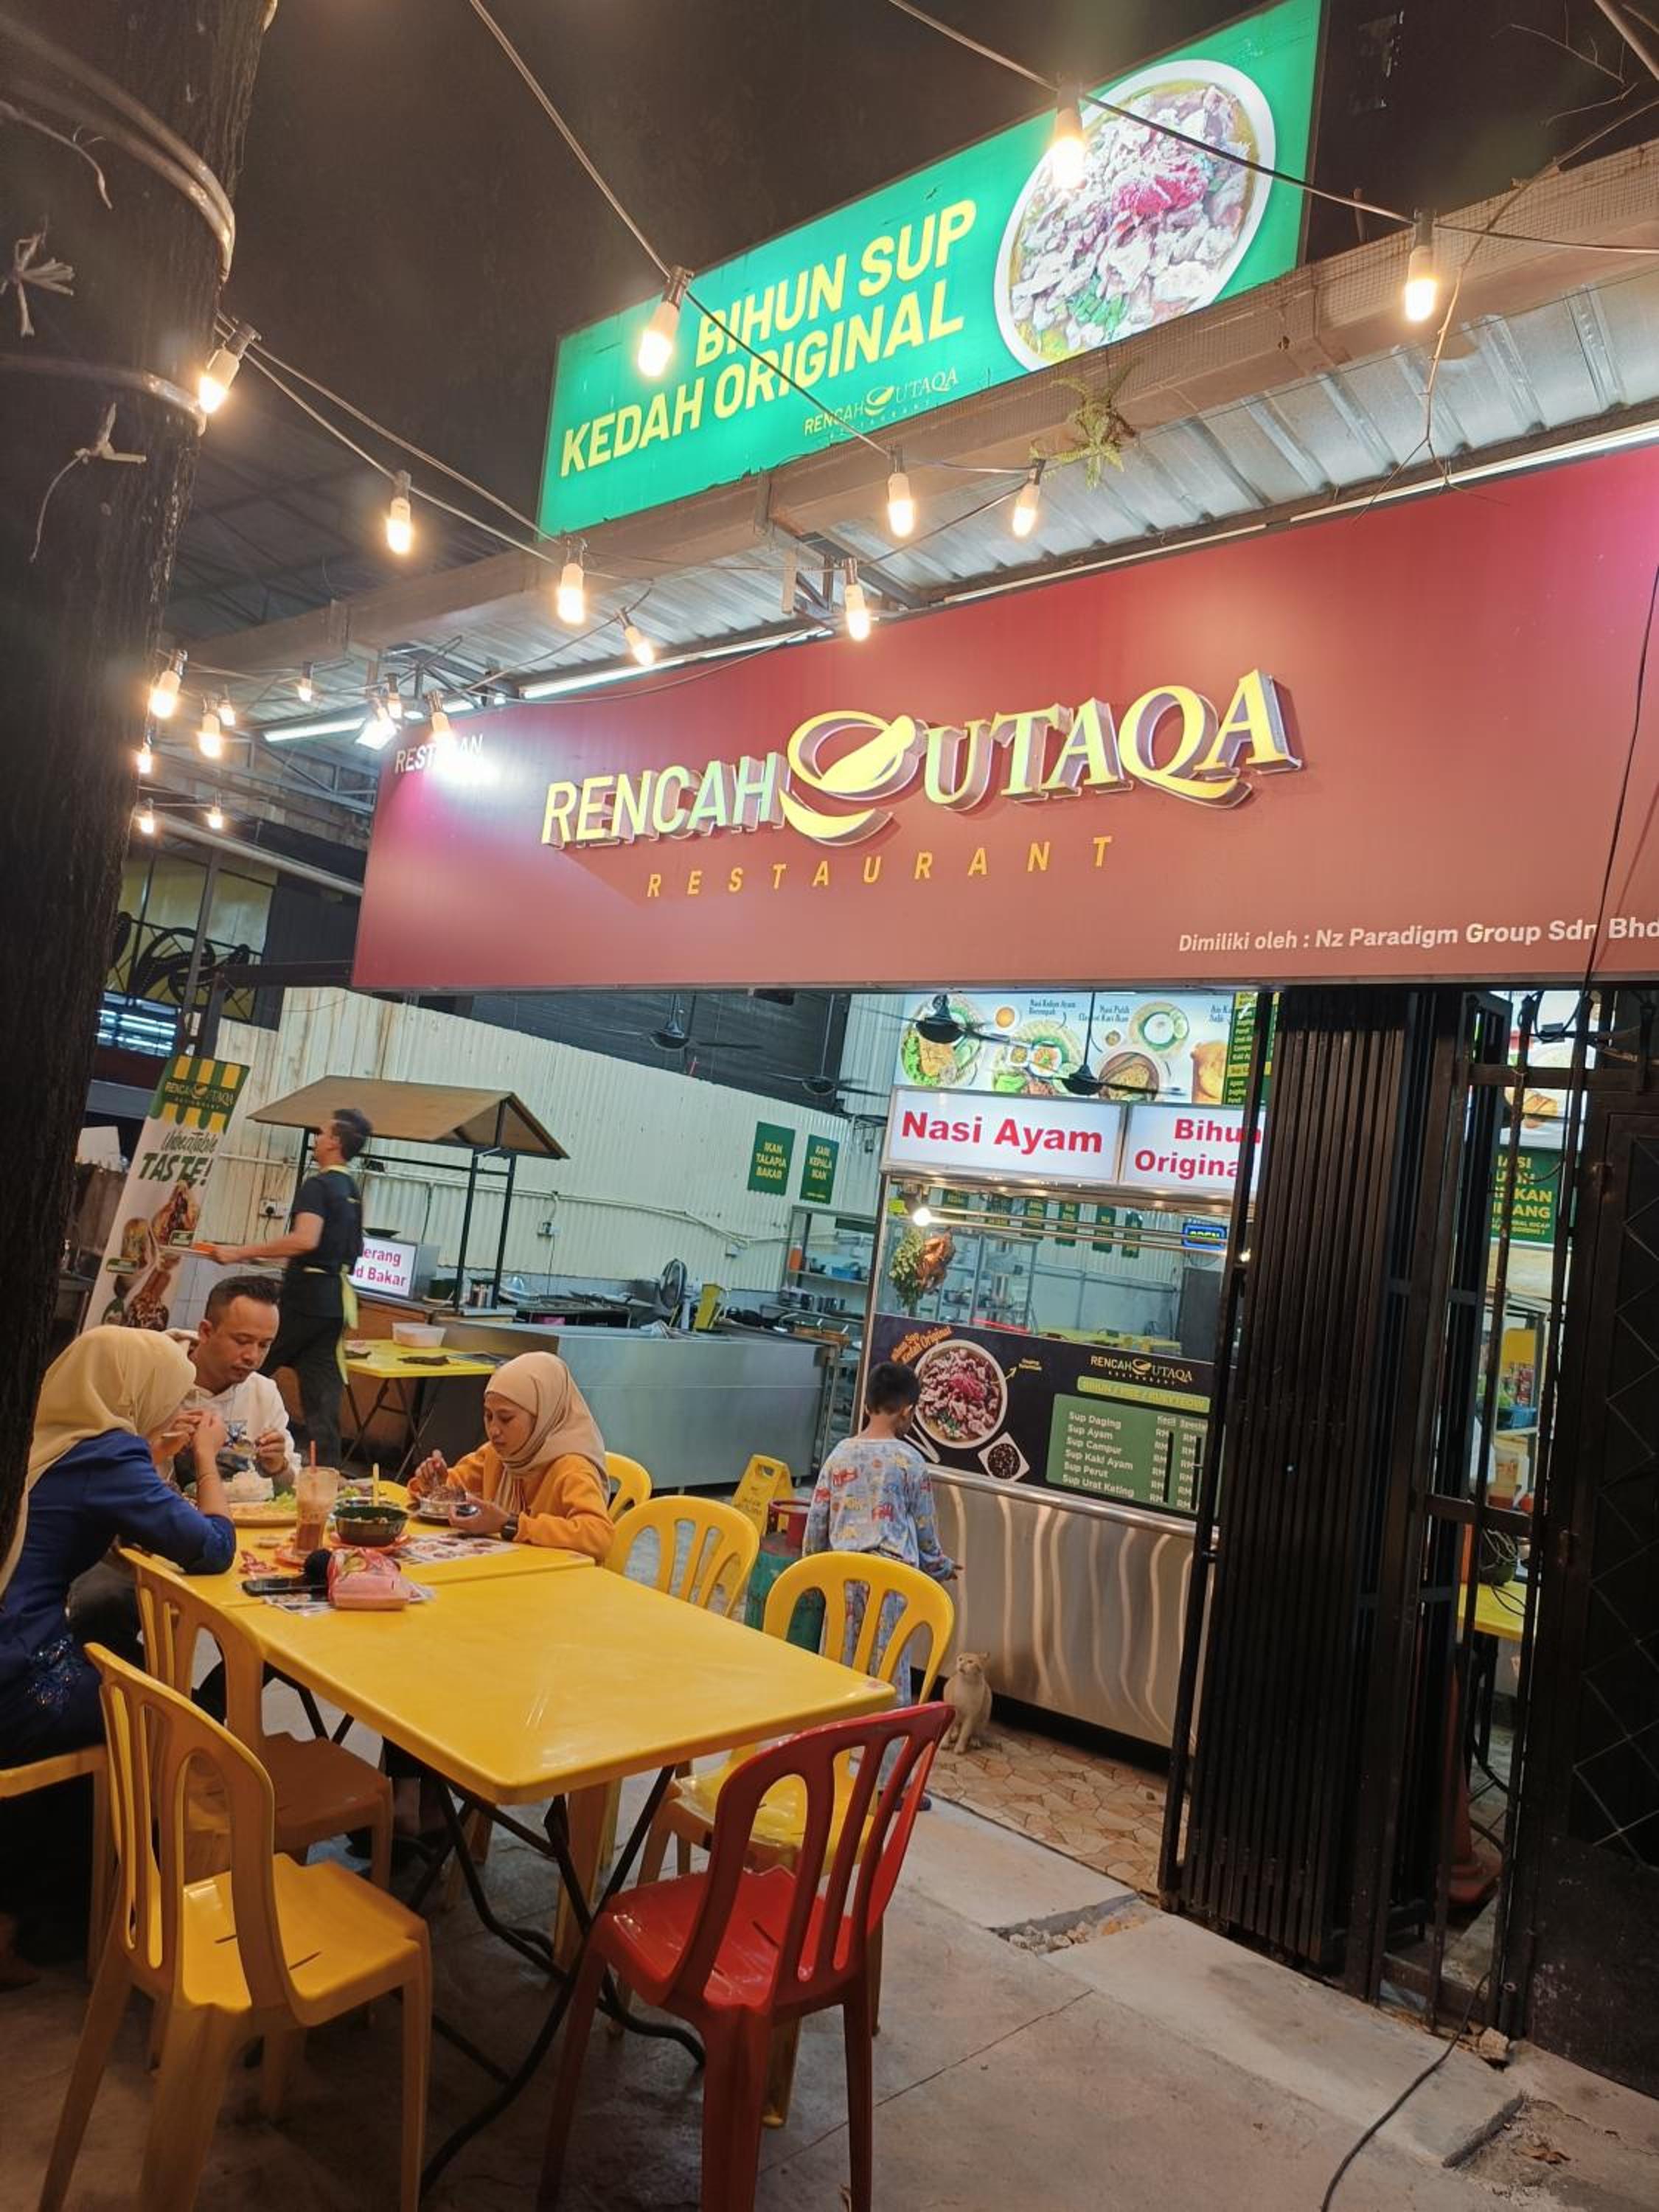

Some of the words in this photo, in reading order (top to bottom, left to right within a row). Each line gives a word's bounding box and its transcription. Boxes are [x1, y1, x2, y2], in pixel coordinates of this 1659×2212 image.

[695, 253, 847, 367] BIHUN
[858, 199, 977, 297] SUP
[560, 378, 705, 478] KEDAH
[714, 279, 965, 419] ORIGINAL
[804, 400, 865, 437] RENCAH
[896, 366, 958, 403] UTAQA
[395, 734, 483, 773] RESTAN
[542, 751, 791, 849] RENCAH
[924, 669, 1296, 808] UTAQA
[647, 836, 1112, 897] RESTAURANT
[1179, 932, 1251, 951] Dimiliki
[1255, 930, 1298, 949] oleh
[1315, 930, 1343, 947] Nz
[1349, 926, 1458, 949] Paradigm
[1466, 922, 1541, 945] Group
[902, 1110, 981, 1144] Nasi
[994, 1118, 1103, 1155] Ayam
[139, 1152, 213, 1186] TASTE!
[1135, 1150, 1239, 1180] Origina
[363, 1248, 402, 1267] erang
[367, 1266, 407, 1286] Bakar
[1091, 1355, 1133, 1371] RENCAH
[1152, 1366, 1193, 1382] UTAQA
[1067, 1424, 1085, 1436] Sup
[1088, 1427, 1113, 1440] Ayam
[1068, 1411, 1087, 1424] Sup
[1088, 1414, 1121, 1430] Daging
[1065, 1449, 1082, 1461] Sup
[1085, 1452, 1105, 1464] Kaki
[1107, 1457, 1133, 1470] Ayam
[1066, 1436, 1084, 1449] Sup
[1086, 1440, 1121, 1455] Campur
[1062, 1473, 1080, 1486] Sup
[1064, 1461, 1082, 1473] Sup
